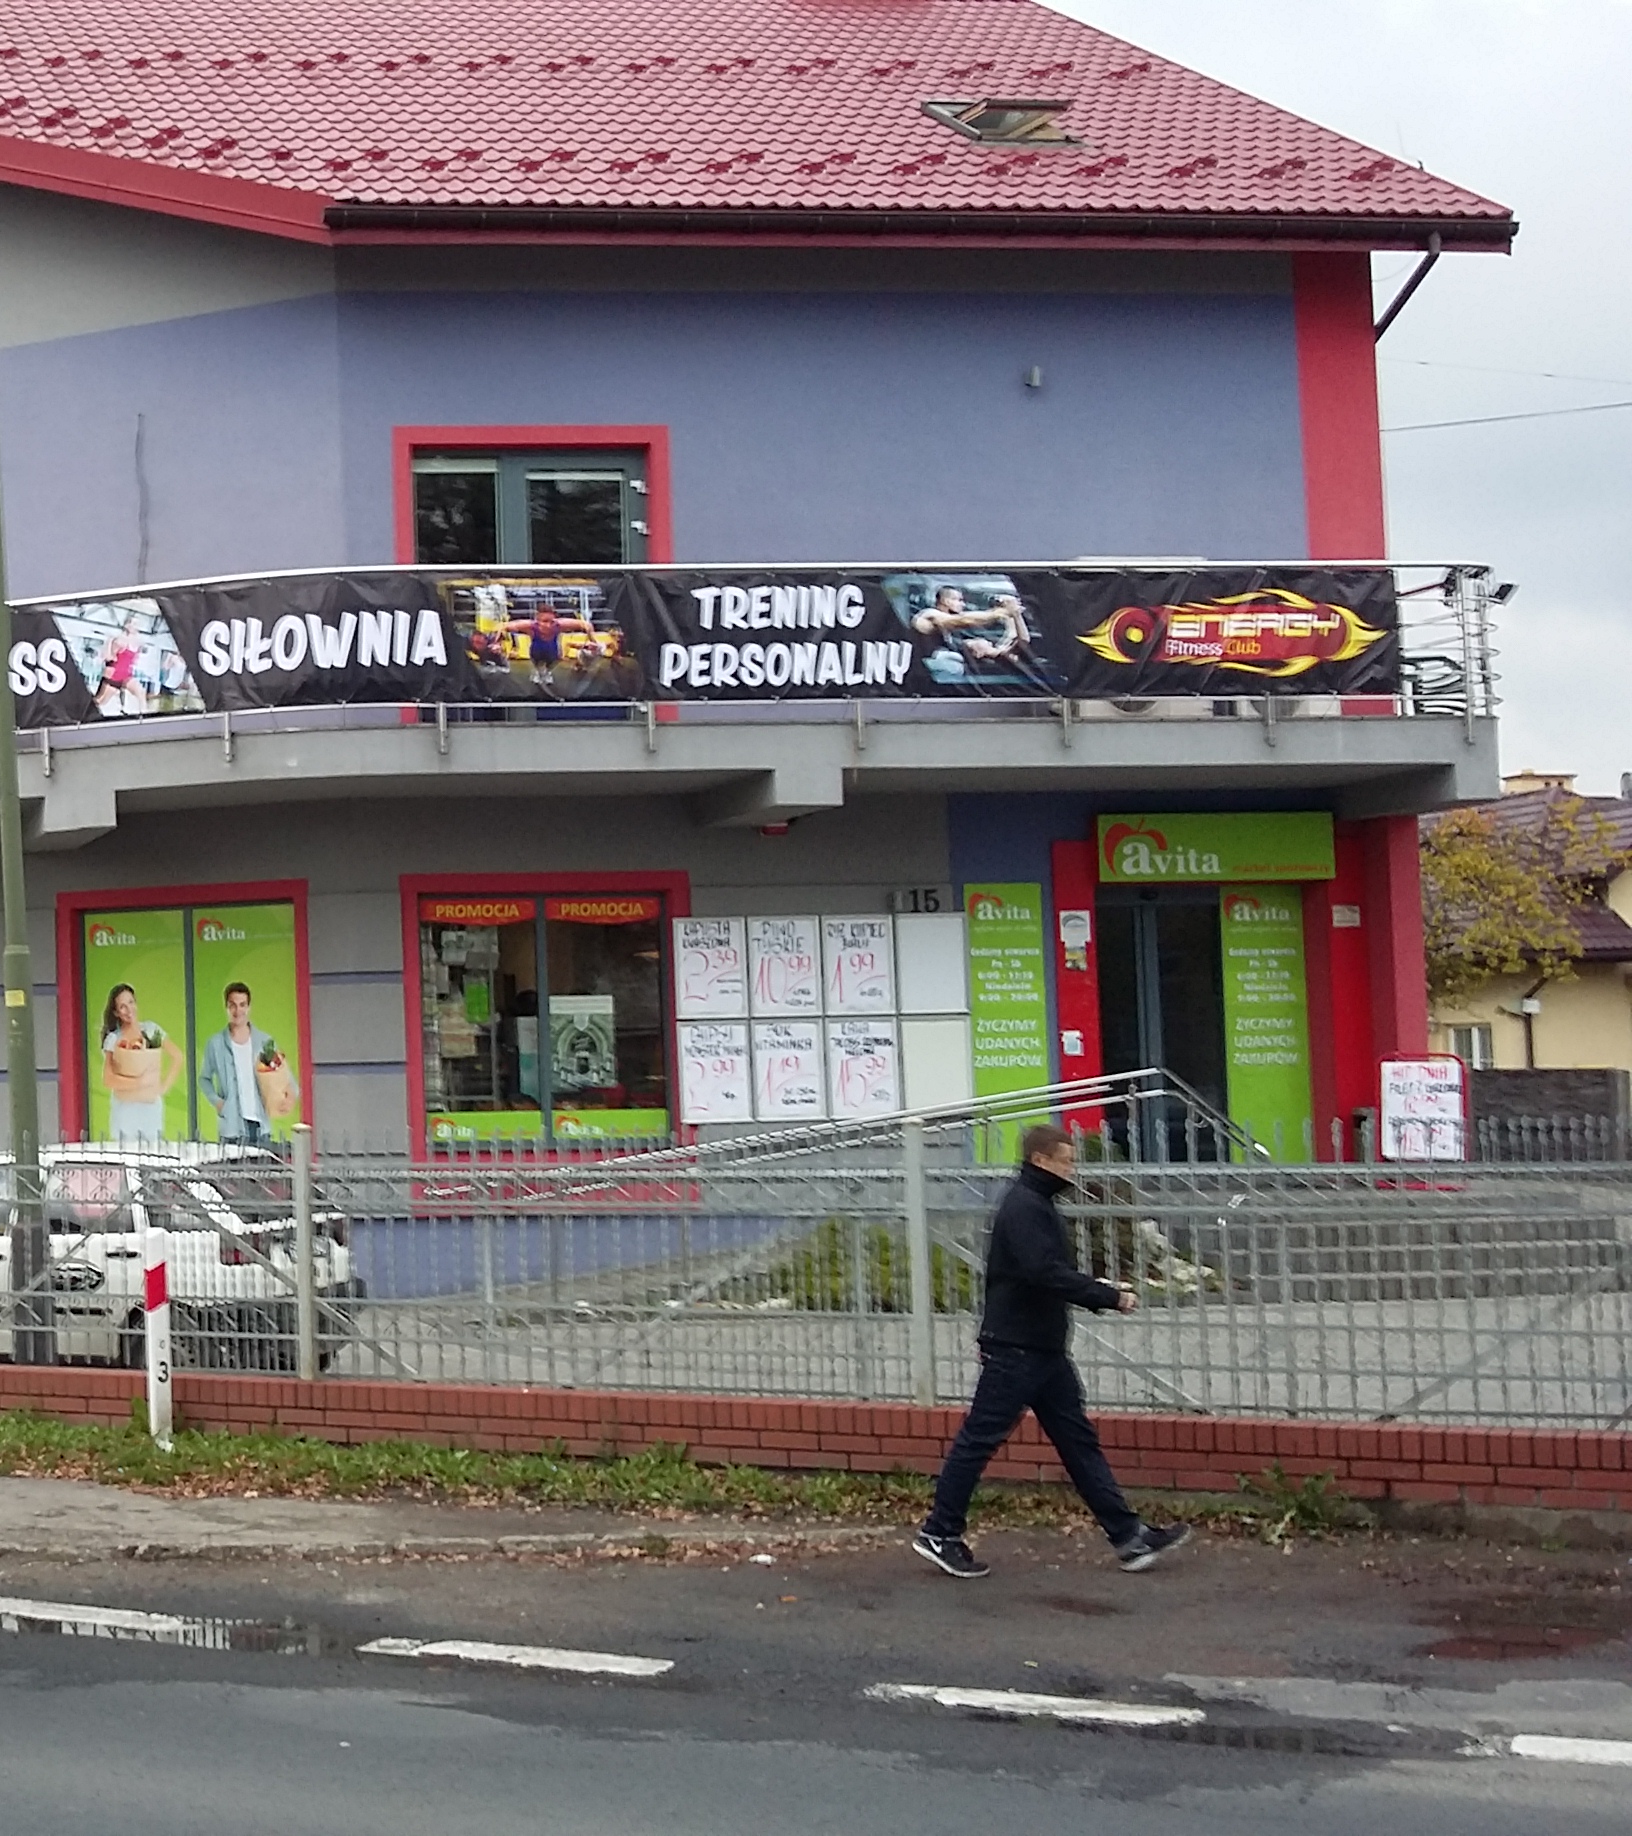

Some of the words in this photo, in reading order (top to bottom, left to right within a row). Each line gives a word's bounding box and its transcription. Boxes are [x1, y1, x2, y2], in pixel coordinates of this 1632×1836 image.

[690, 584, 865, 629] TRENING
[1169, 613, 1340, 638] ENERGY
[198, 610, 447, 676] SIŁOWNIA
[1166, 640, 1223, 656] Fitness
[1224, 639, 1260, 655] Club
[660, 641, 912, 687] PERSONALNY
[1122, 841, 1221, 875] avita
[560, 902, 644, 917] PROMOCJA
[909, 889, 940, 913] 15
[435, 903, 519, 919] PROMOCJA
[978, 902, 1031, 920] avita
[1234, 903, 1290, 921] avita
[95, 928, 136, 946] avita
[203, 924, 246, 941] avita
[977, 1017, 1037, 1033] ŻYCZYMY
[975, 1037, 1041, 1050] UDANYCH
[1234, 1035, 1296, 1048] UDANYCH
[974, 1053, 1042, 1068] ZAKUPÓW
[157, 1361, 169, 1383] 3
